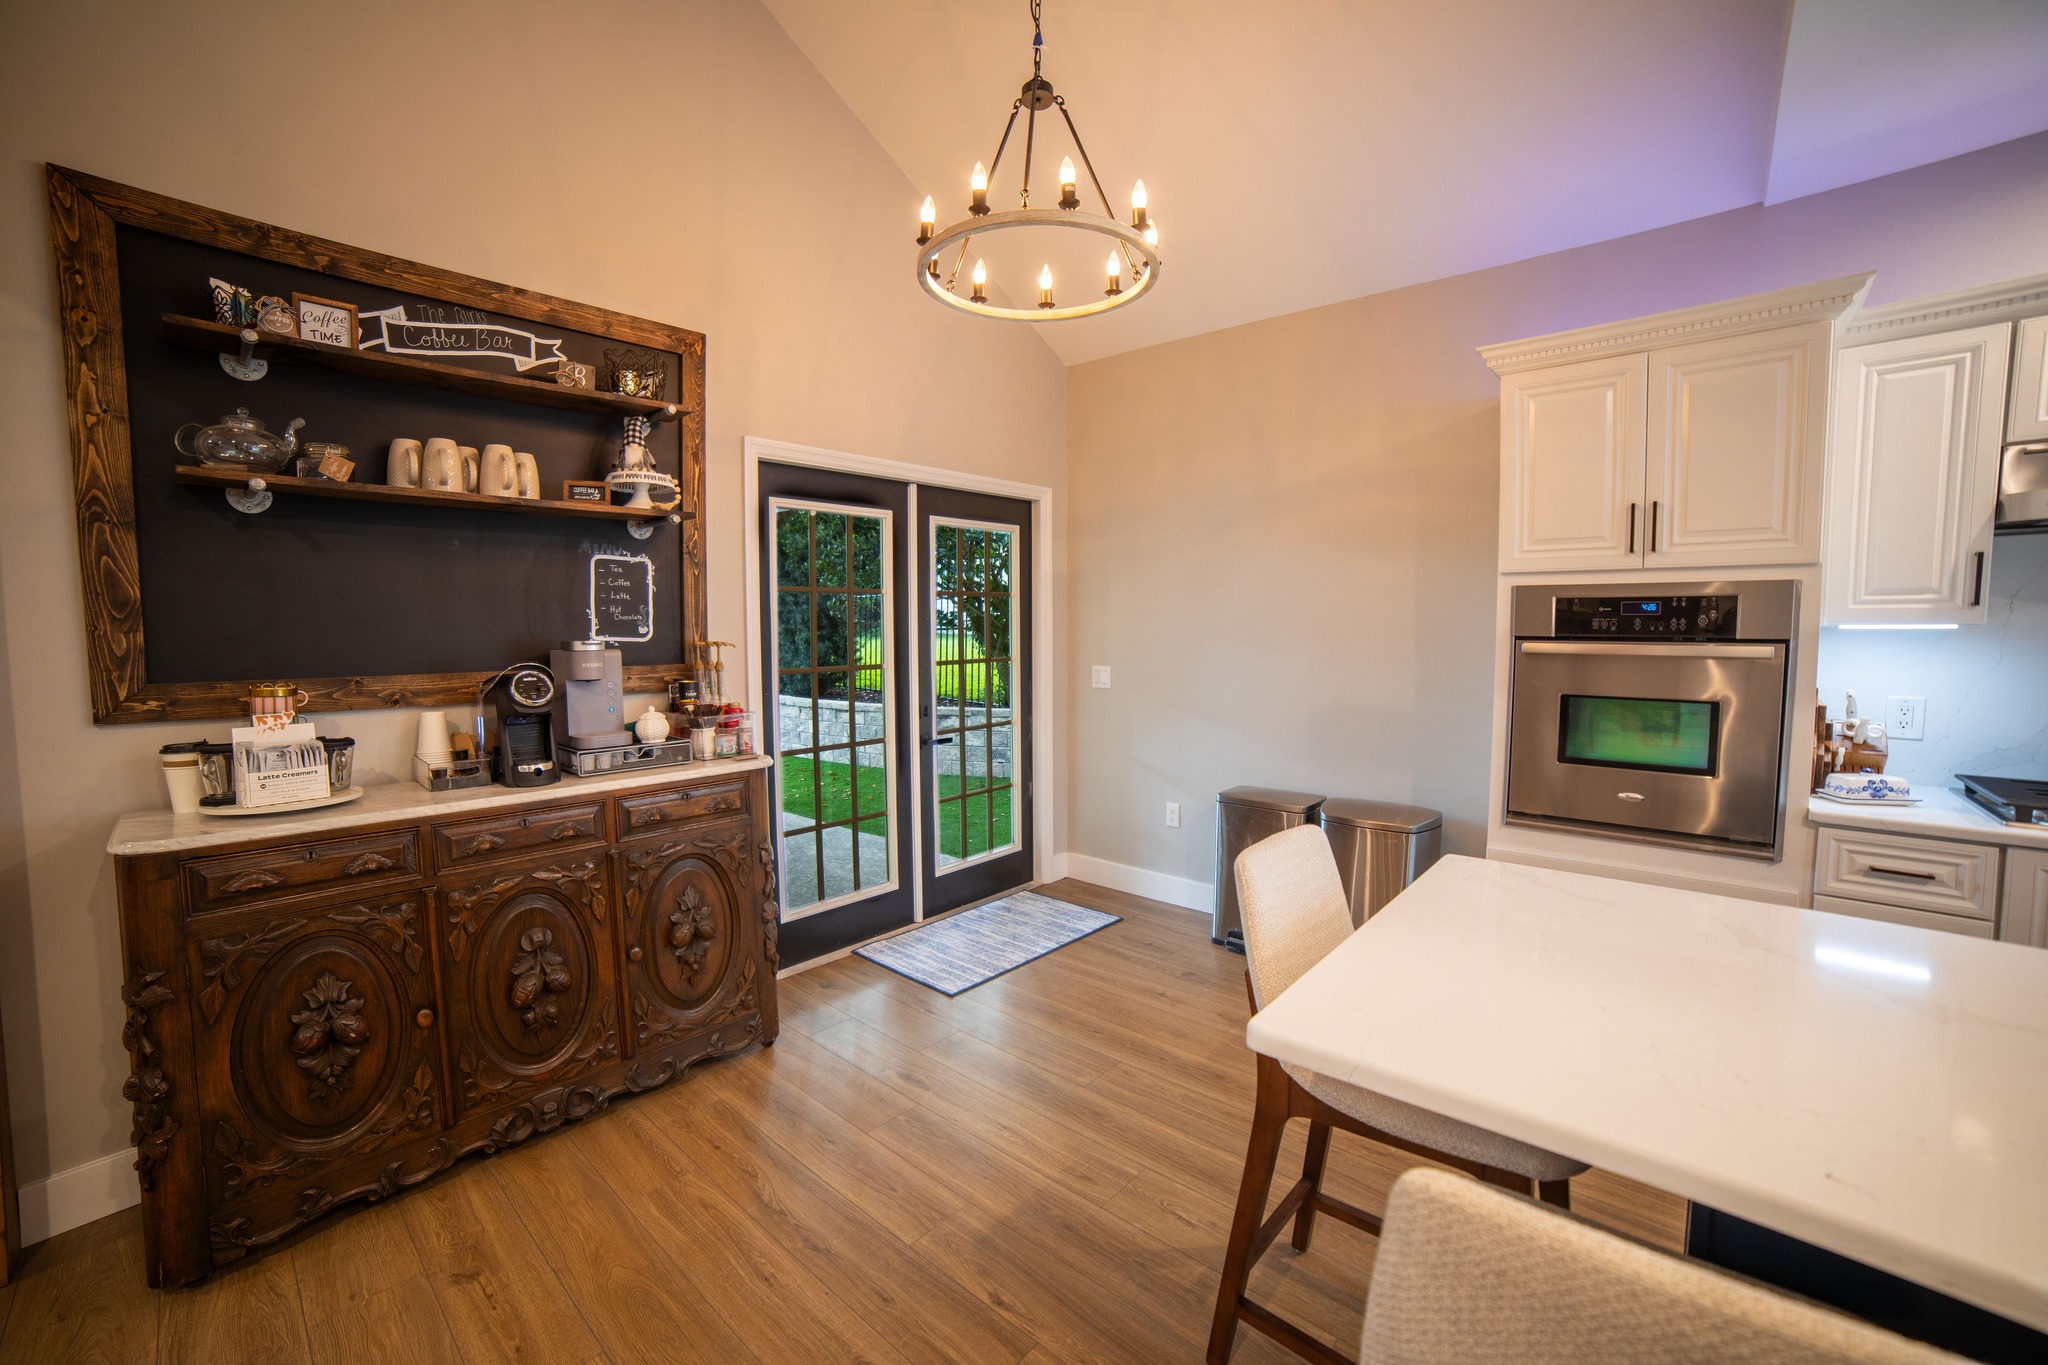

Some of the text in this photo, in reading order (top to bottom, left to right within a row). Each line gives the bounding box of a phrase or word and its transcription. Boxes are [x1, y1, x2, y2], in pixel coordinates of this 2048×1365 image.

[265, 315, 292, 325] COFFEE
[300, 310, 347, 328] Coffee
[416, 304, 488, 326] The Burks
[310, 329, 343, 344] TIME
[402, 325, 514, 351] Coffee Bar
[609, 564, 624, 573] Tea
[608, 578, 631, 587] Coffee
[610, 591, 632, 600] Latte
[609, 605, 622, 614] Hot
[613, 613, 643, 621] Chocolate
[281, 769, 319, 779] Creamers
